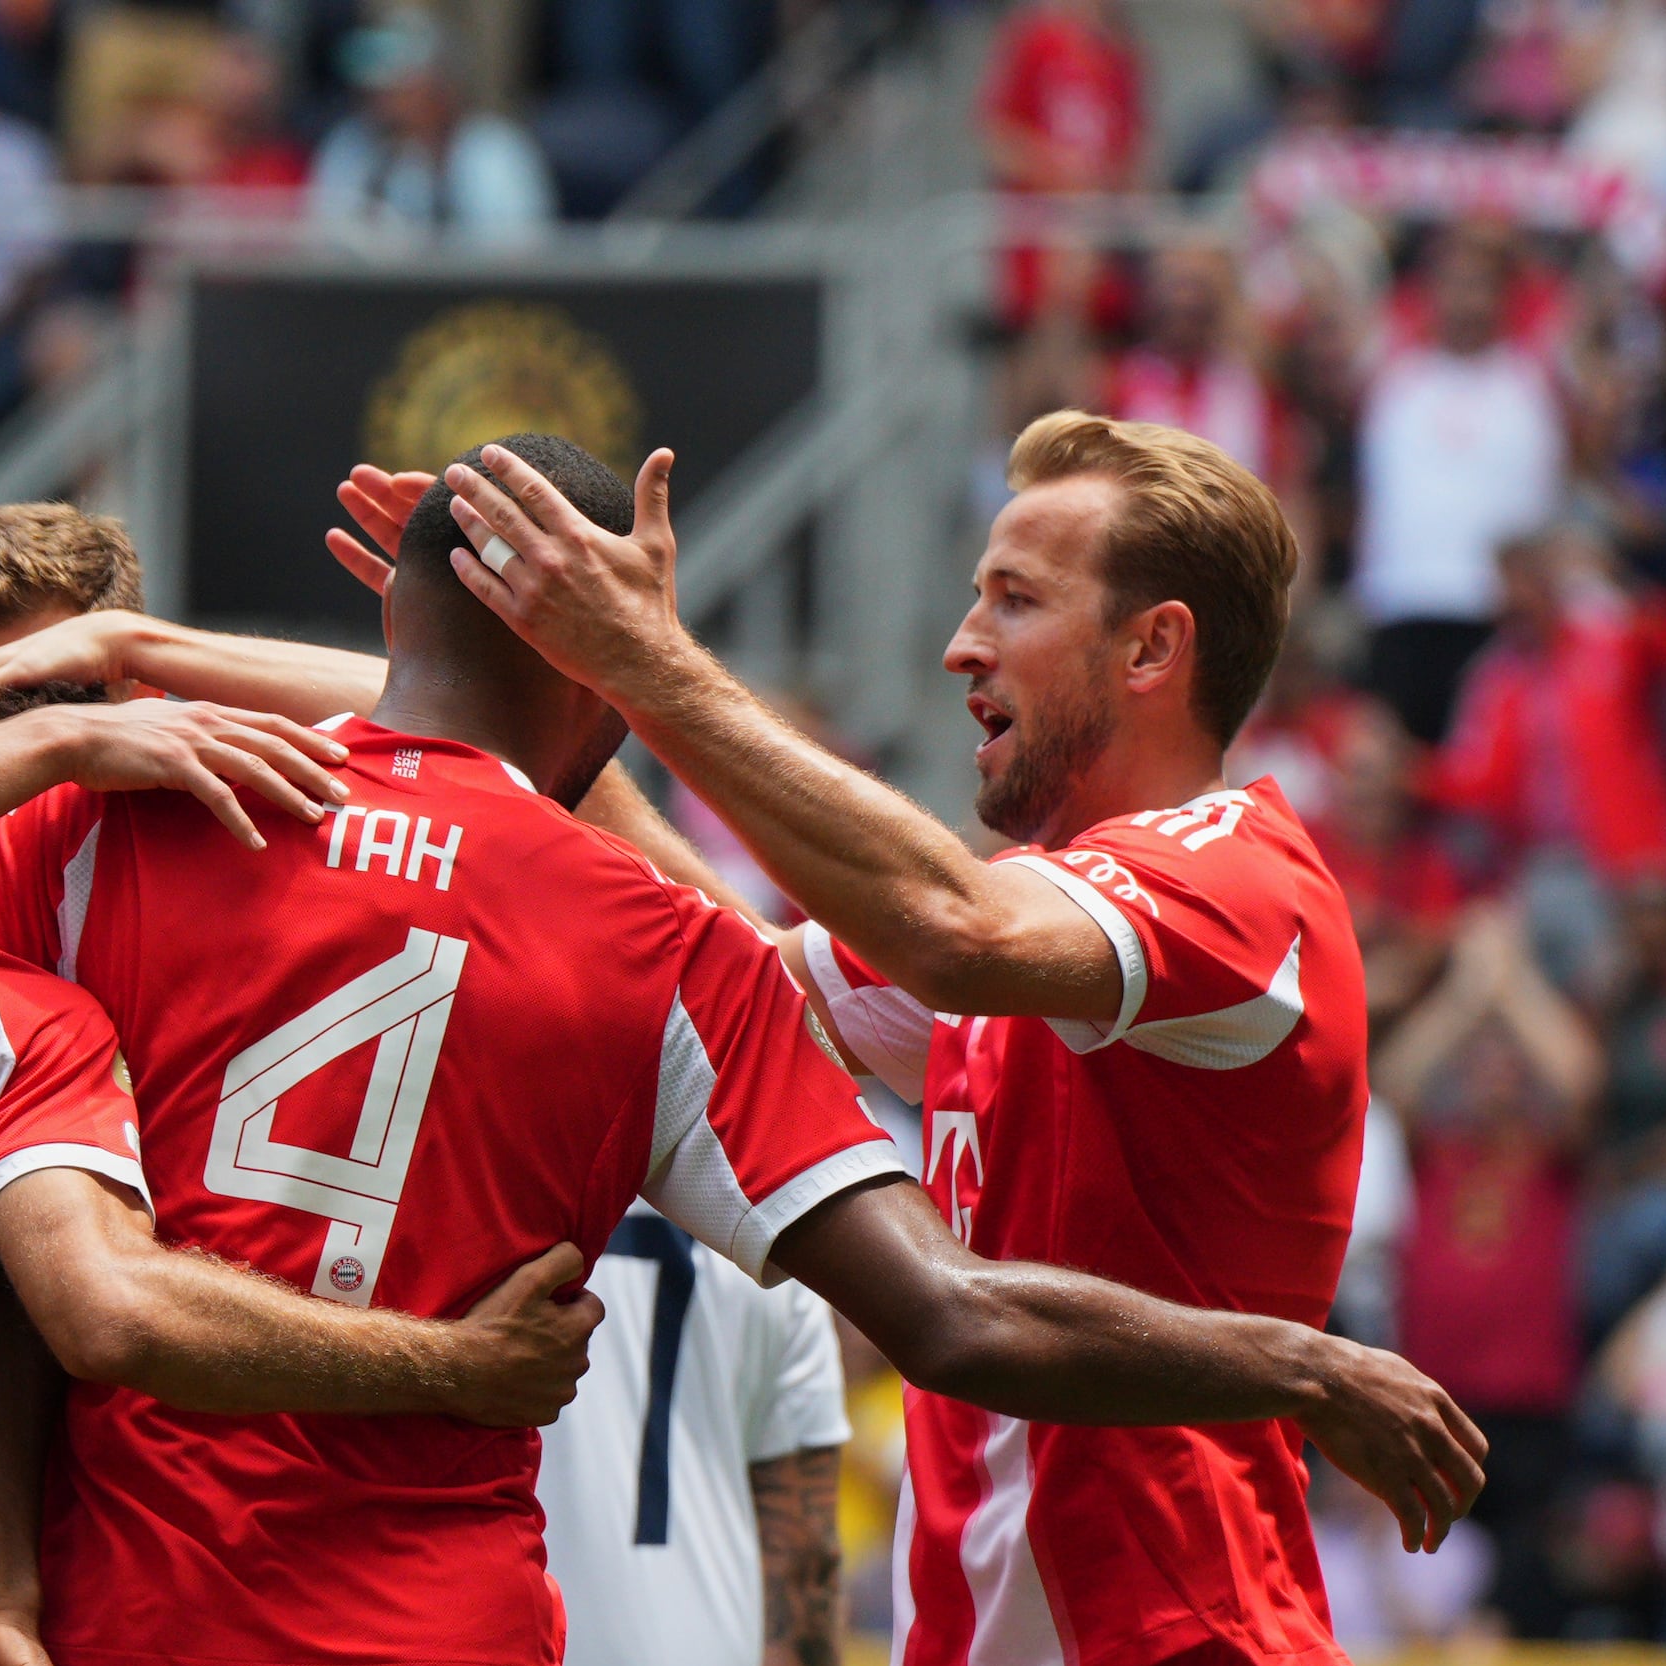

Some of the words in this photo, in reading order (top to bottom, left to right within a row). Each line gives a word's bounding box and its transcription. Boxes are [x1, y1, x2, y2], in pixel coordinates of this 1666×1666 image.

[391, 766, 418, 780] MIA
[393, 756, 421, 770] SAN
[322, 801, 464, 892] TAH
[205, 927, 469, 1307] 4
